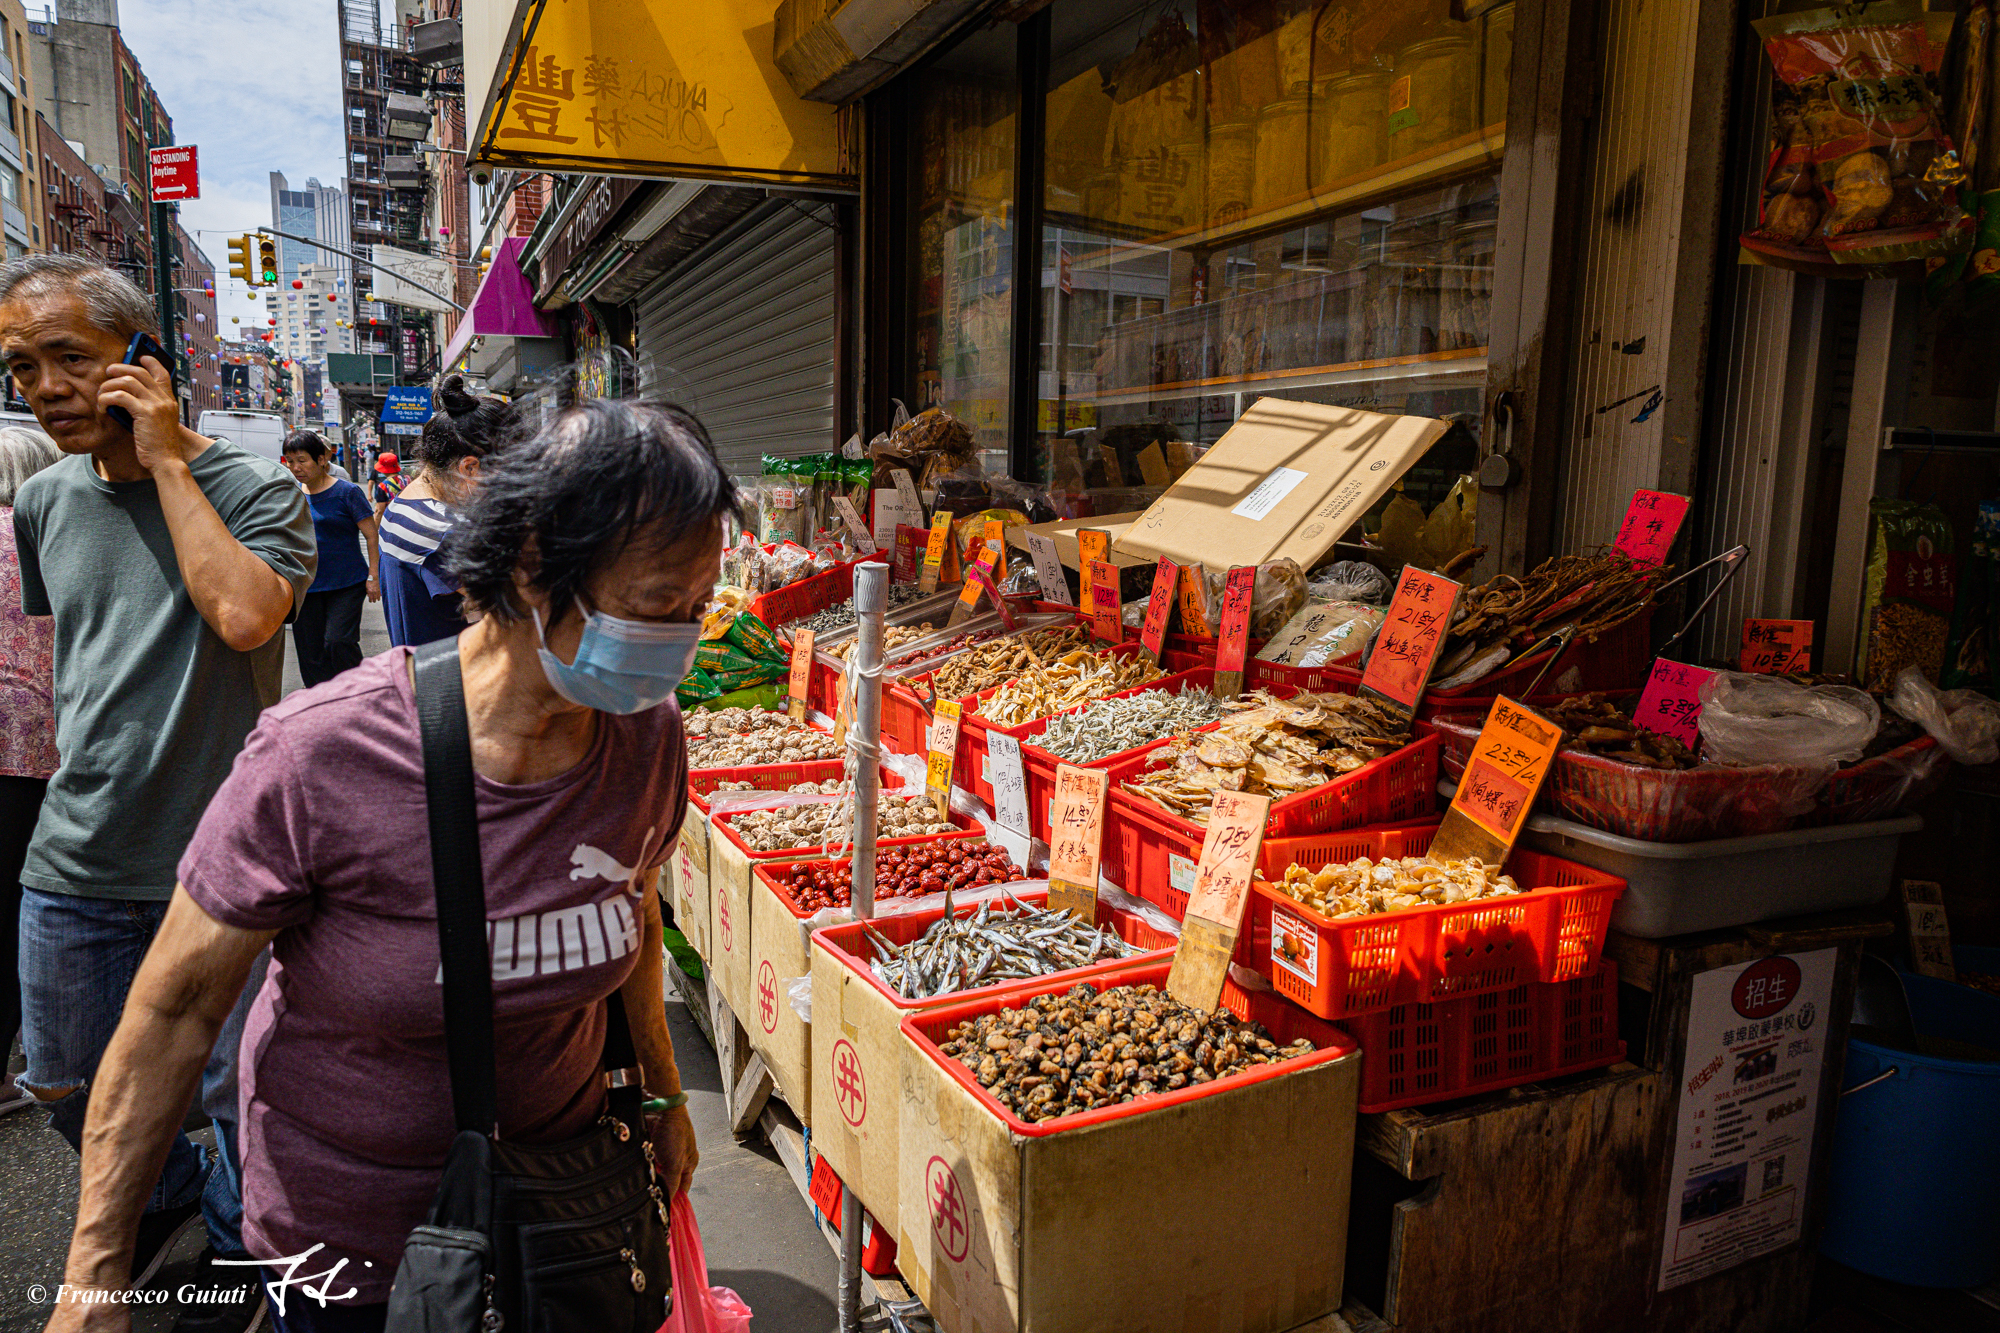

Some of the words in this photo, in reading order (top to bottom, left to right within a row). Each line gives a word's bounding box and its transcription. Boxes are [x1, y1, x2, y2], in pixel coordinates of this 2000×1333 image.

[153, 154, 161, 165] NO
[162, 152, 190, 164] STANDING
[154, 165, 177, 178] Anytime
[1745, 974, 1787, 1010] 招生
